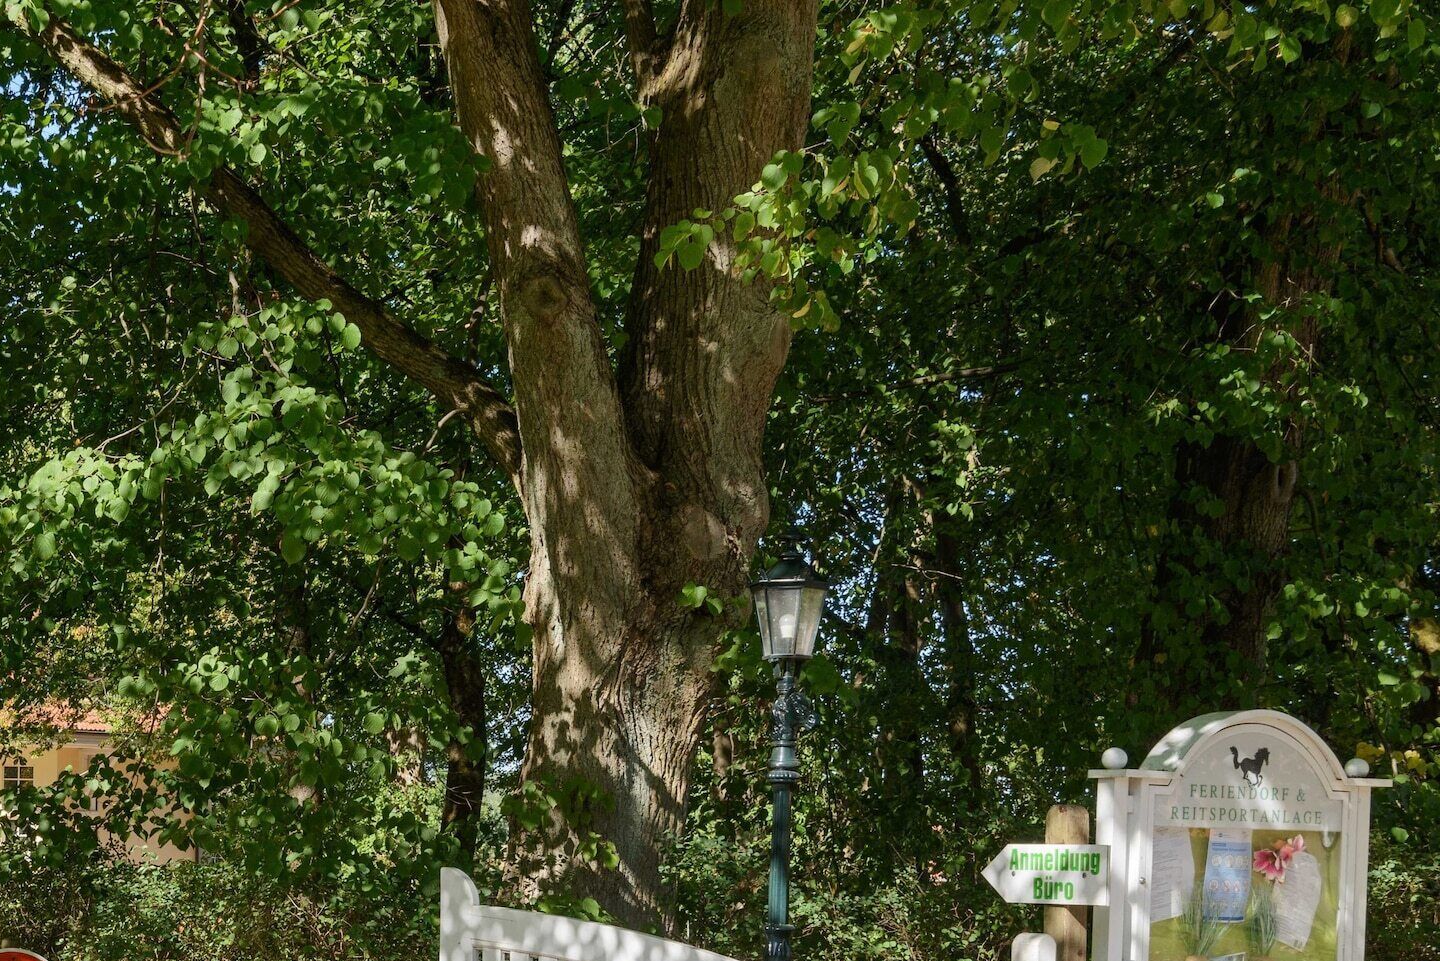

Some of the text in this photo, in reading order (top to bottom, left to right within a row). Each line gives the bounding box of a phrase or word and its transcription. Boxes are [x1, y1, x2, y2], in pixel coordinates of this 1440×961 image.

[1190, 784, 1306, 801] FERIENDORF &
[1170, 806, 1323, 825] REITSPORTANLAGE
[1009, 848, 1100, 876] Anmeldung
[1033, 876, 1074, 900] Büro
